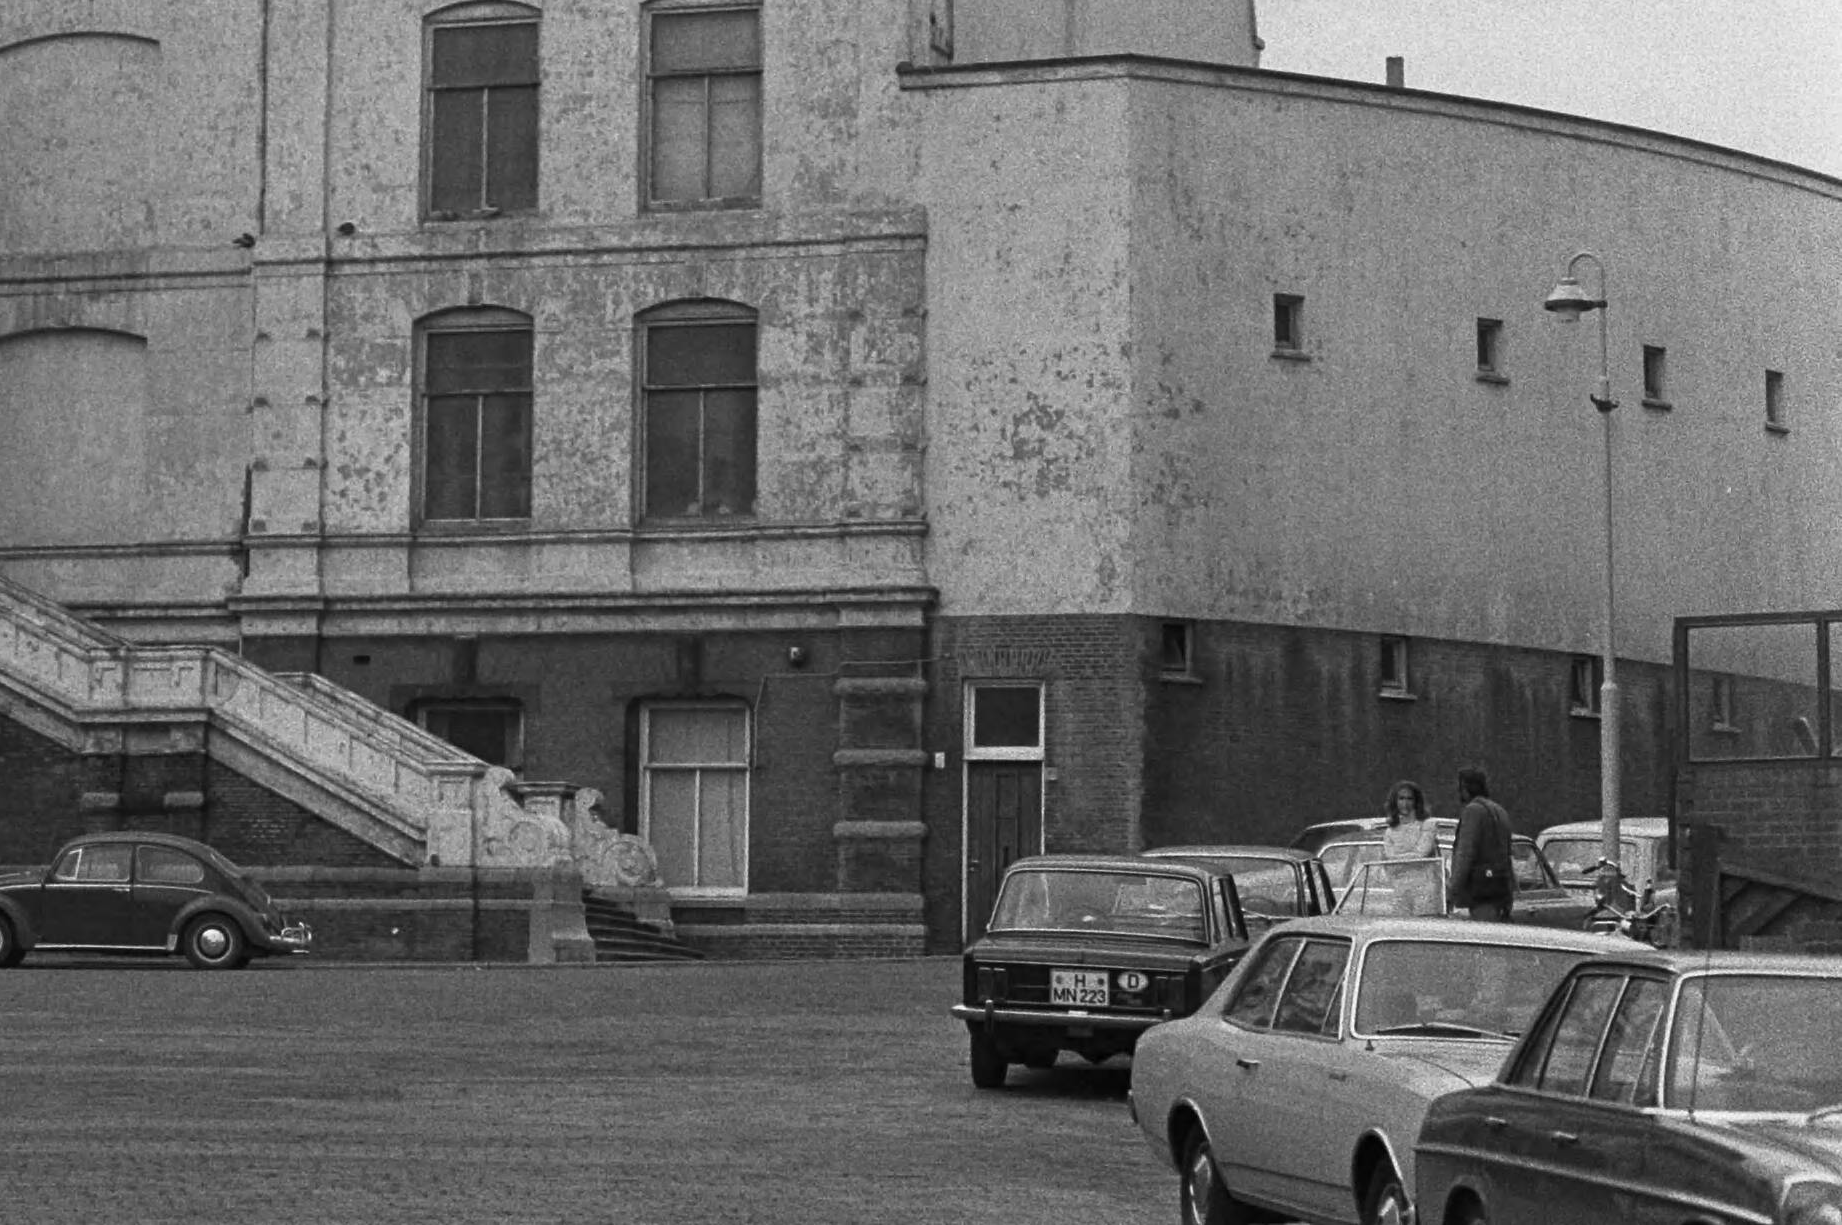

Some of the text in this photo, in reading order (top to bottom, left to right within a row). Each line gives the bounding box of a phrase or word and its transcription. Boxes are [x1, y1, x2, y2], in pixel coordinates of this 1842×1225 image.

[1074, 974, 1086, 987] H
[1128, 974, 1139, 988] D
[1053, 987, 1077, 1002] MN
[1079, 989, 1106, 1003] 223
